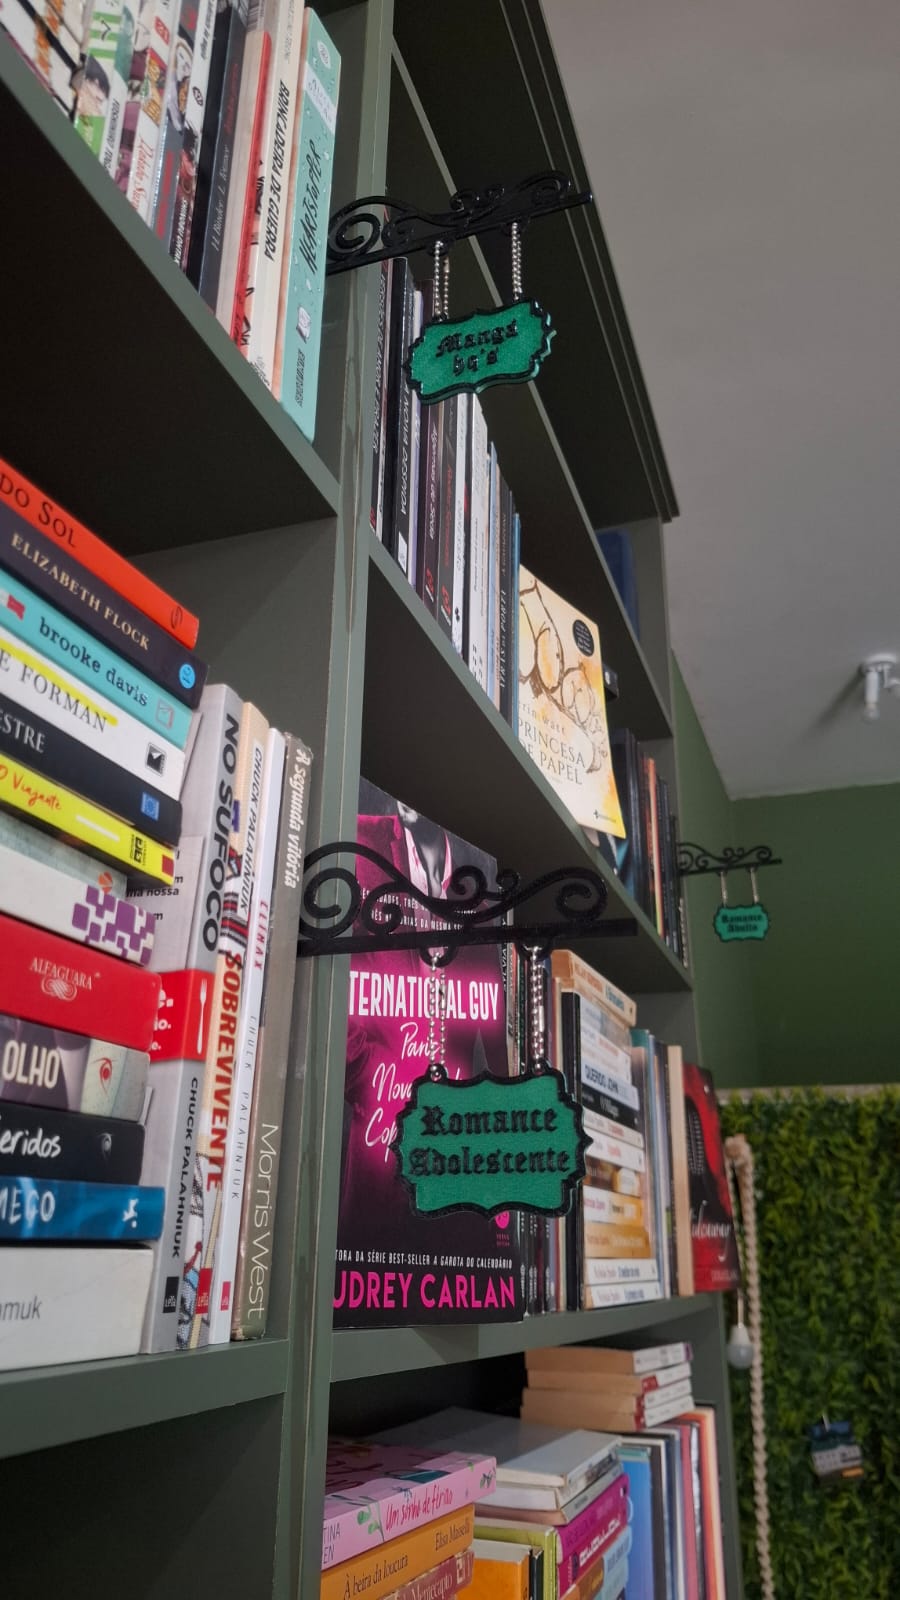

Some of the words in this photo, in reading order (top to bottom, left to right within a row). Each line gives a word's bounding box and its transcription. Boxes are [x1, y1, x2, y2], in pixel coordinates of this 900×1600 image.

[271, 79, 290, 173] BRINCADEIRA
[269, 175, 282, 199] DE
[264, 198, 280, 262] GUERRA
[436, 318, 518, 358] Manga
[401, 395, 409, 446] NOIVA
[400, 446, 408, 516] DESPIDA
[0, 473, 30, 508] DO
[38, 501, 76, 548] SOL
[428, 503, 436, 541] Seda
[11, 533, 101, 612] ELIZABETH
[103, 606, 150, 650] FLOCK
[39, 616, 101, 673] brooke
[106, 668, 148, 707] davis
[20, 663, 108, 733] FORMAN
[222, 712, 241, 775] NO
[296, 748, 311, 766] A
[539, 750, 583, 785] PAPEL
[250, 747, 263, 809] CHUCK
[289, 767, 307, 832] segunda
[202, 779, 234, 953] SUFOCO
[239, 811, 258, 915] PALAHNIUK
[283, 833, 305, 889] vitória
[146, 886, 180, 897] nossa
[254, 900, 268, 971] CLIMAX
[29, 956, 93, 991] ALFAGUARA
[469, 980, 499, 1021] GUY
[2, 1039, 61, 1089] OLHO
[206, 948, 243, 1192] SOBREVIVENTE
[244, 1015, 257, 1070] CHUCK
[184, 1077, 199, 1140] CHUCK
[420, 1104, 558, 1137] Romance
[232, 1091, 251, 1200] PALAHNIUK
[408, 1146, 571, 1177] Adolescente
[172, 1144, 192, 1259] PALAHNIUK
[253, 1122, 279, 1228] Morris
[247, 1230, 272, 1320] West
[355, 1250, 365, 1263] DA
[367, 1249, 387, 1264] SÉRIE
[389, 1252, 431, 1266] BEST-SELLER
[440, 1256, 464, 1268] GAROTA
[466, 1257, 475, 1268] DO
[476, 1257, 513, 1270] CALENDÁRIO
[0, 1296, 42, 1321] muk
[420, 1273, 516, 1309] CARLAN
[385, 1504, 400, 1532] Um
[422, 1496, 431, 1514] de
[435, 1530, 448, 1552] Elisa
[352, 1571, 372, 1597] beira
[373, 1564, 382, 1585] da
[383, 1553, 409, 1580] loucura
